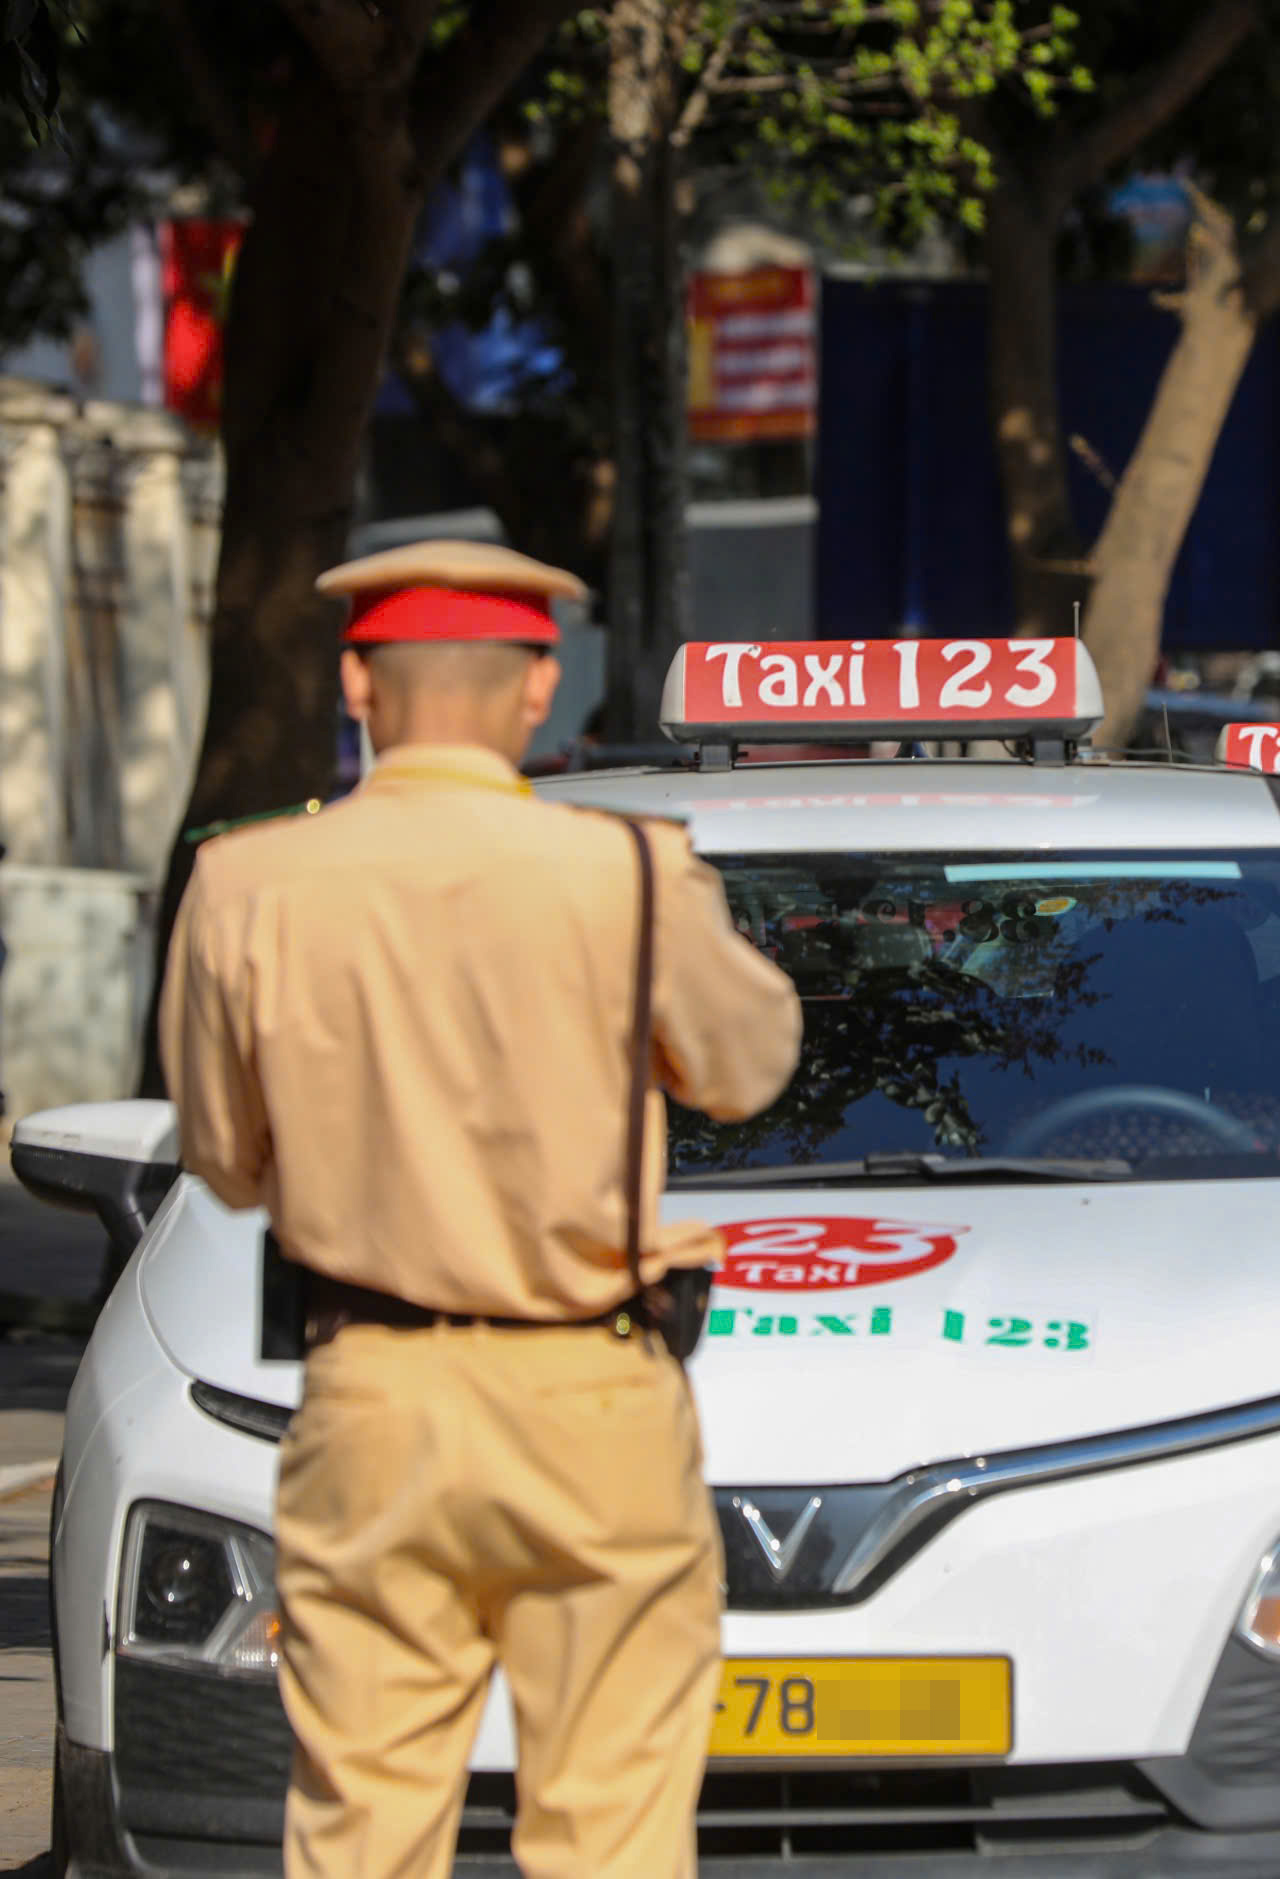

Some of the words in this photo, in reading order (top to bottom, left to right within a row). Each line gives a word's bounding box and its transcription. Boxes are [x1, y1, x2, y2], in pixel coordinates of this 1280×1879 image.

[705, 641, 867, 709] Taxi
[893, 638, 1059, 710] 123
[716, 1221, 972, 1268] 23
[734, 1261, 861, 1284] Taxi
[706, 1306, 893, 1337] Taxi
[940, 1308, 1092, 1352] 123
